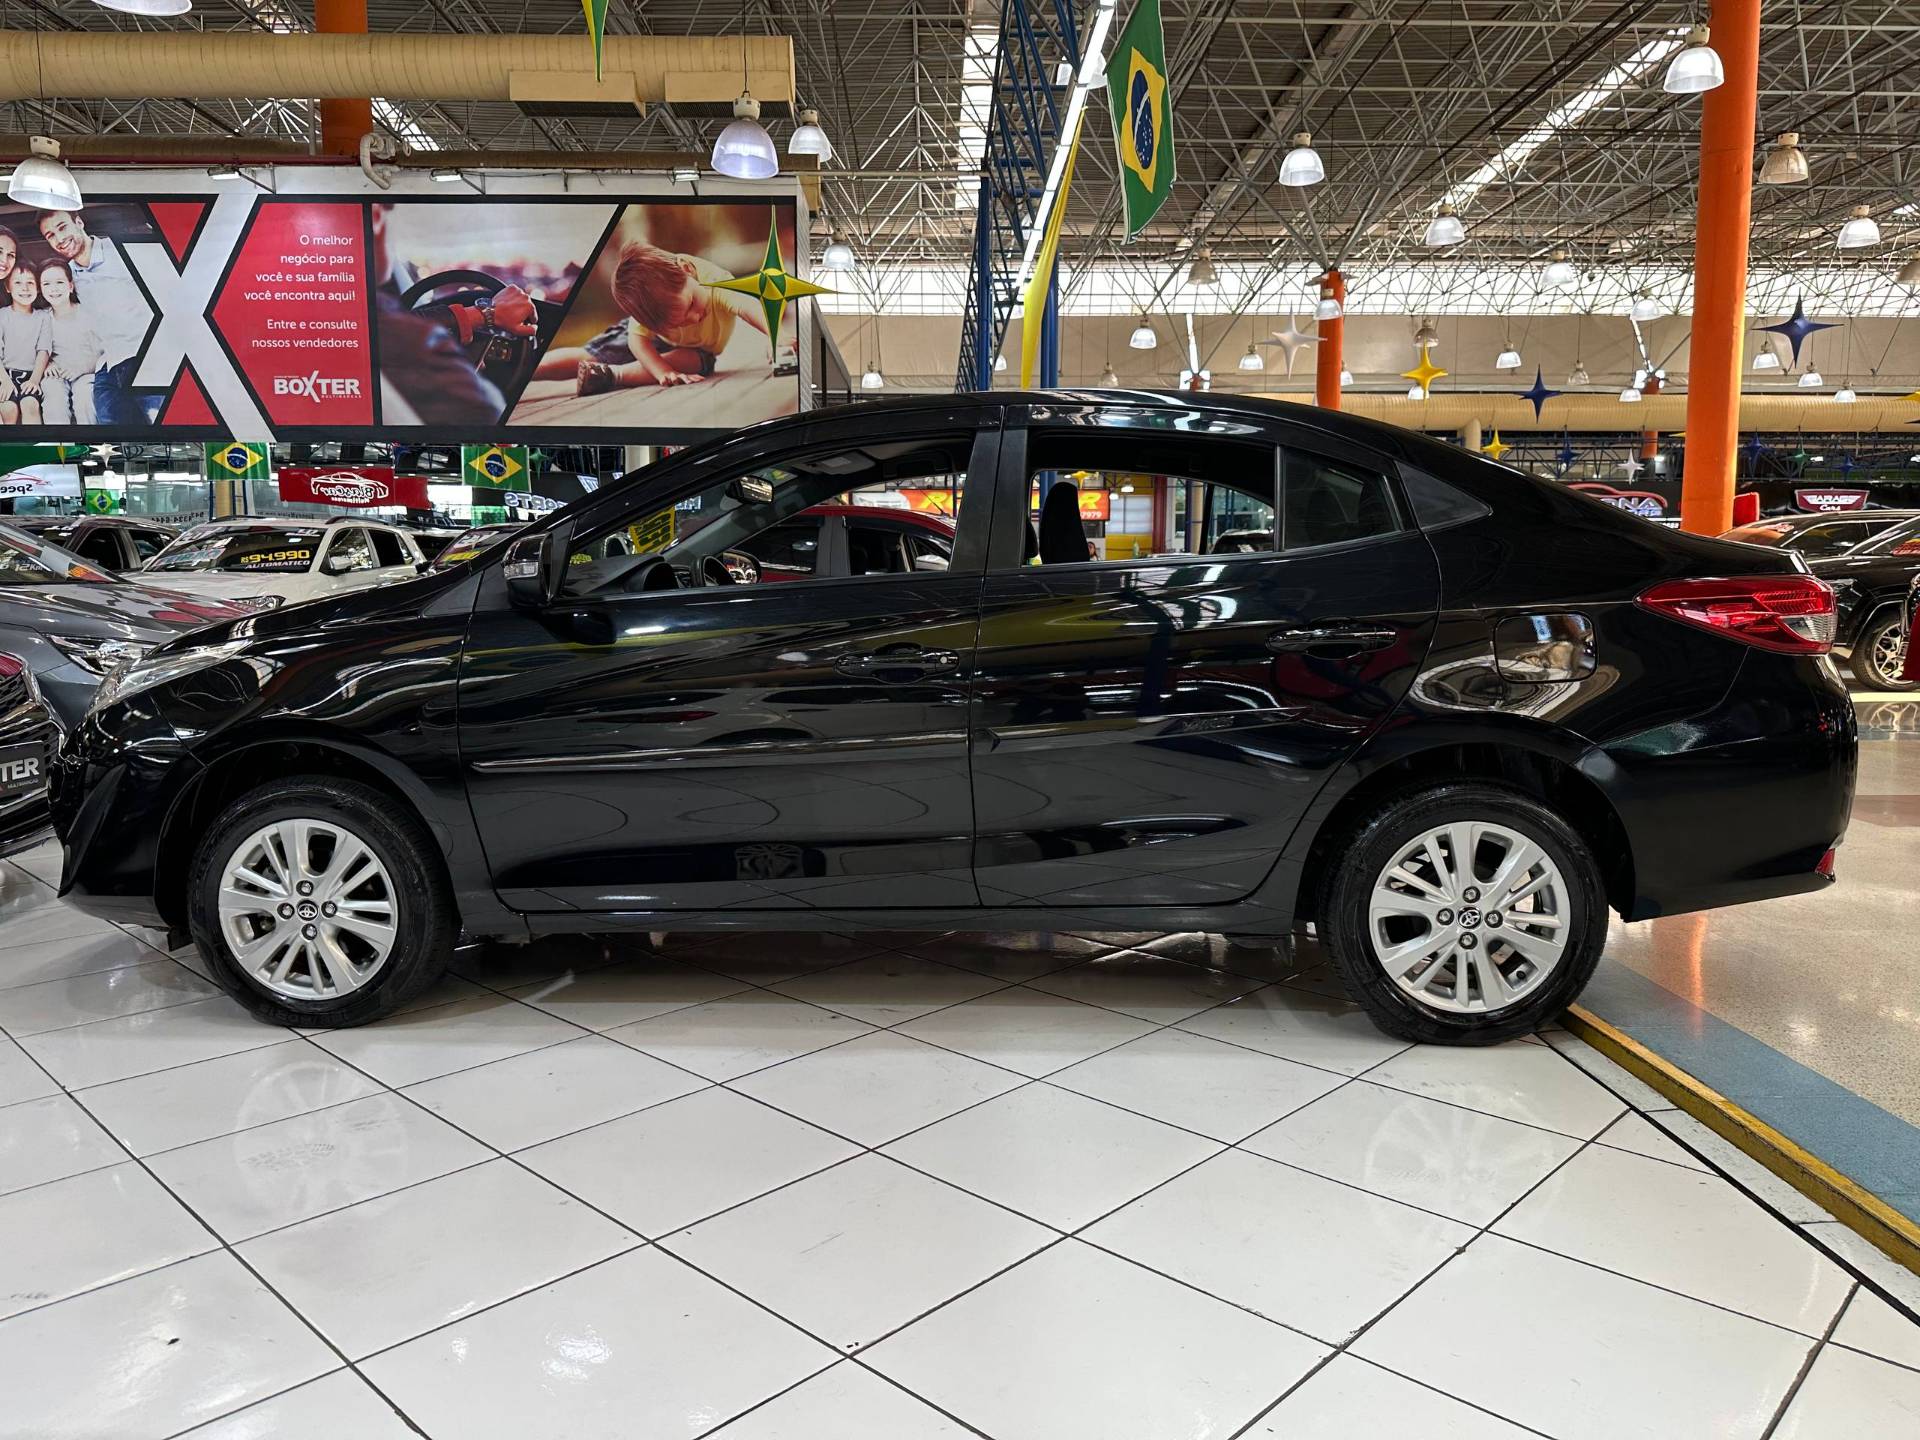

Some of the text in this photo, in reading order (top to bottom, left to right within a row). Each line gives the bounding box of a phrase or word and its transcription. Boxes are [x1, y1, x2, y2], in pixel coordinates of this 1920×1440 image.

[300, 234, 353, 246] O melhor
[280, 253, 354, 266] negócio para
[256, 272, 355, 282] você e sua família
[244, 290, 356, 303] você encontra aqui!
[267, 318, 358, 330] Entre e consulte
[252, 338, 358, 348] nossos vendedores
[274, 370, 361, 403] BOXTER
[245, 559, 310, 569] AUTOMATICO
